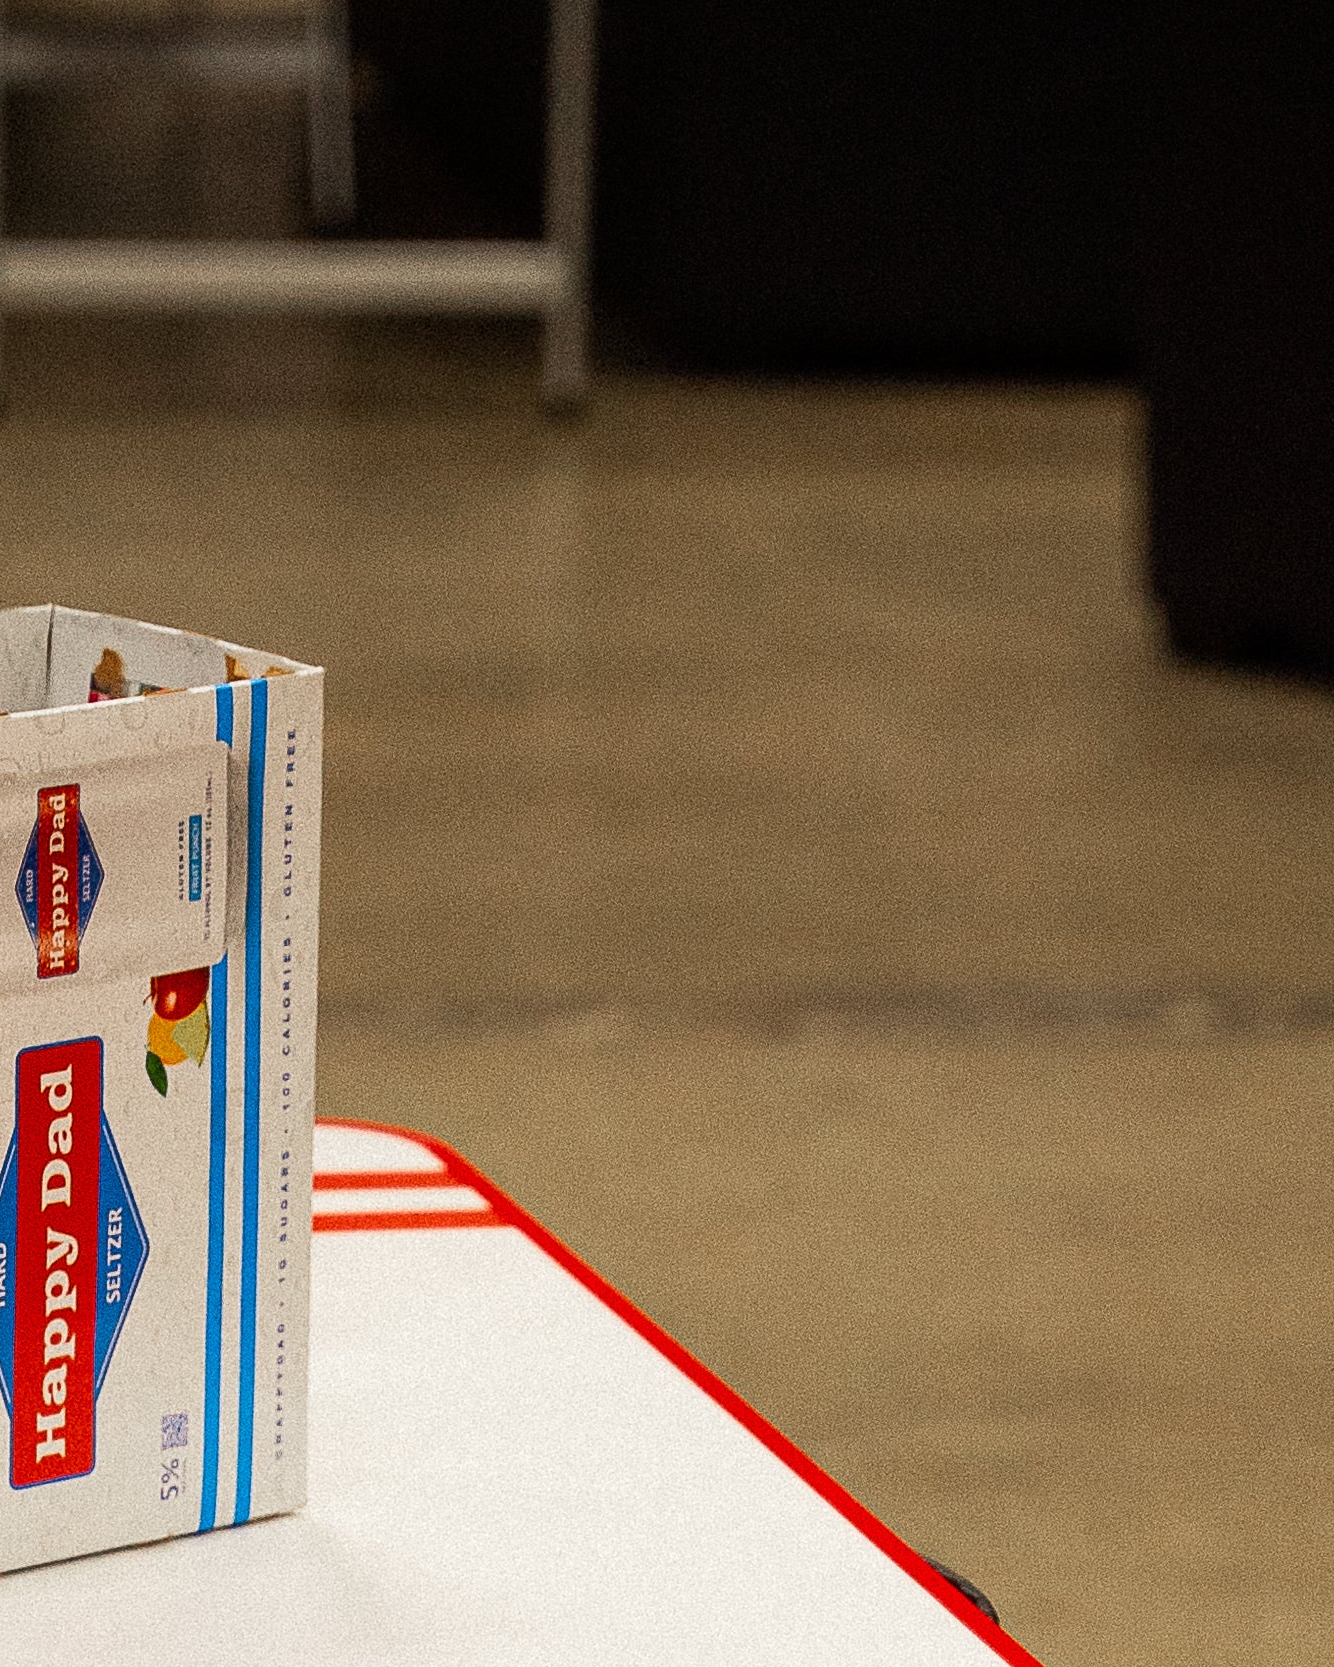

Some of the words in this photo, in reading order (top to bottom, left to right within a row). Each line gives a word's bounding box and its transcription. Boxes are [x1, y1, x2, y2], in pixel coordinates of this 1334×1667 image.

[285, 729, 296, 789] FREE
[48, 794, 66, 855] Dad
[283, 804, 293, 897] GLUTEN
[48, 863, 69, 969] Happy
[282, 937, 292, 1056] CALORIES
[40, 1063, 73, 1212] Dad
[282, 1070, 291, 1112] 100
[280, 1150, 290, 1242] SUGARS
[105, 1206, 123, 1303] SELTZER
[36, 1226, 79, 1464] Happy
[160, 1458, 180, 1501] 5%
